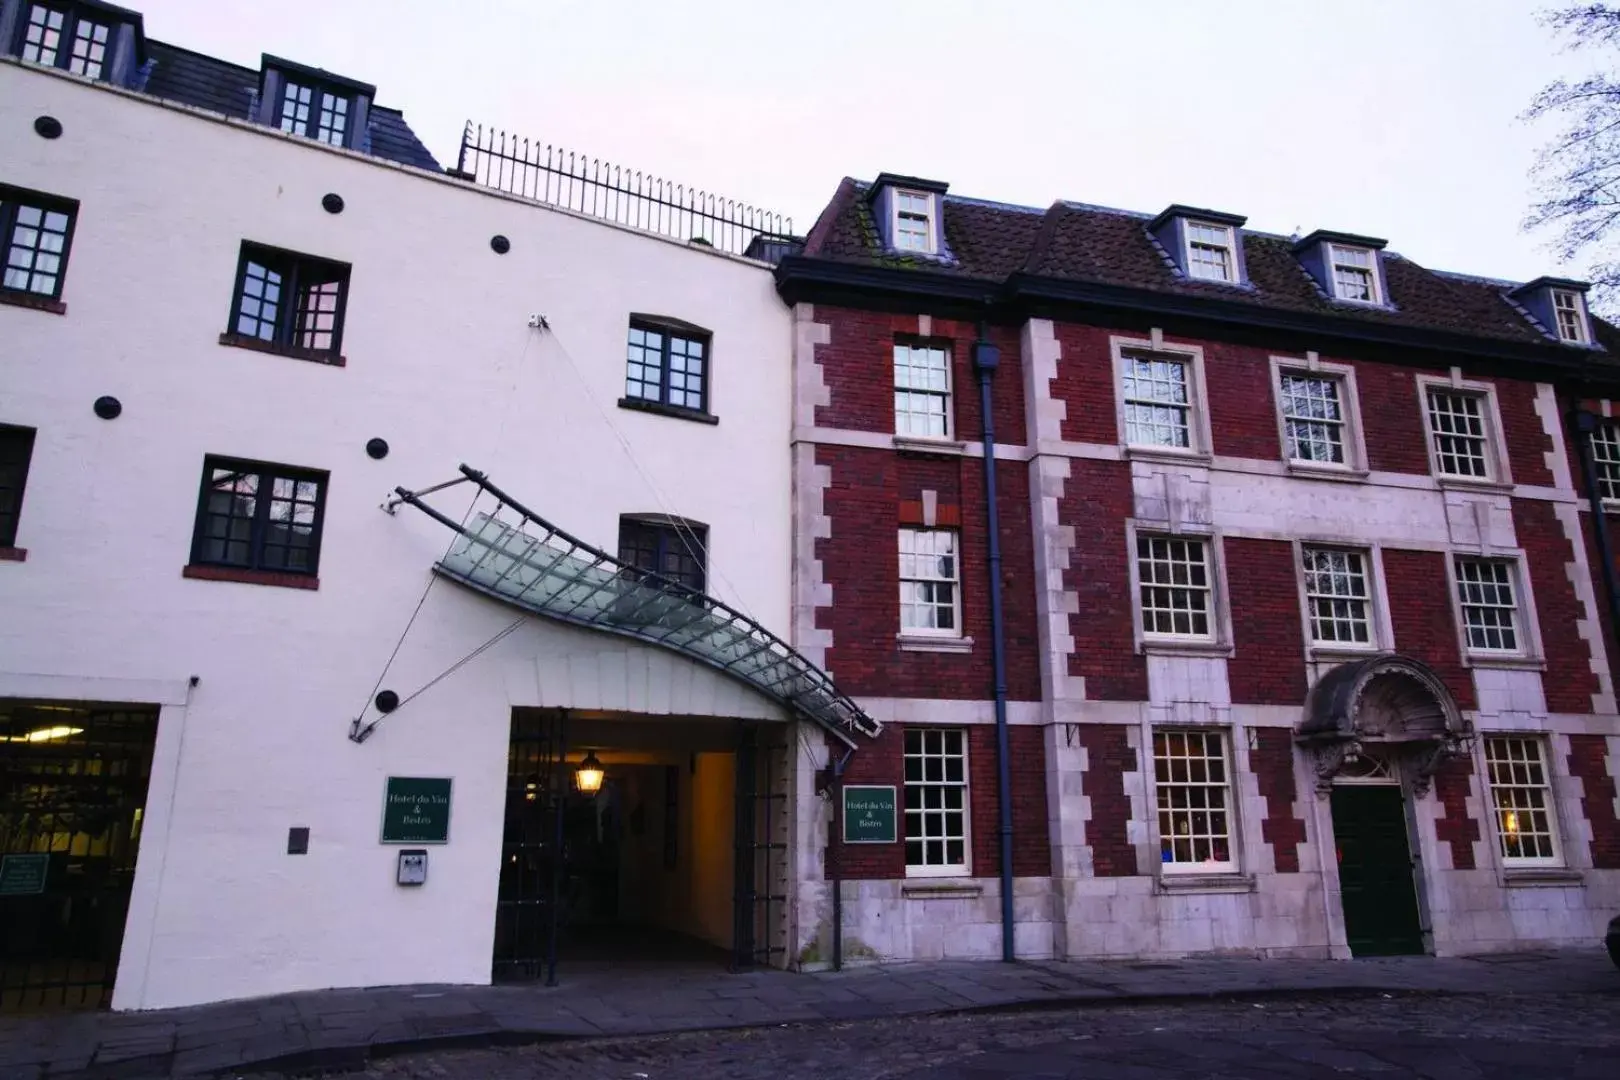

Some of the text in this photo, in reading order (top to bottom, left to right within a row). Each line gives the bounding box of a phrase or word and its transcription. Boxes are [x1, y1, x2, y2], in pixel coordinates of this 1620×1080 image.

[390, 794, 415, 803] Hotel
[417, 794, 430, 803] du
[413, 804, 421, 814] &
[847, 801, 893, 810] Hotel du Vin
[859, 819, 882, 828] Bistro
